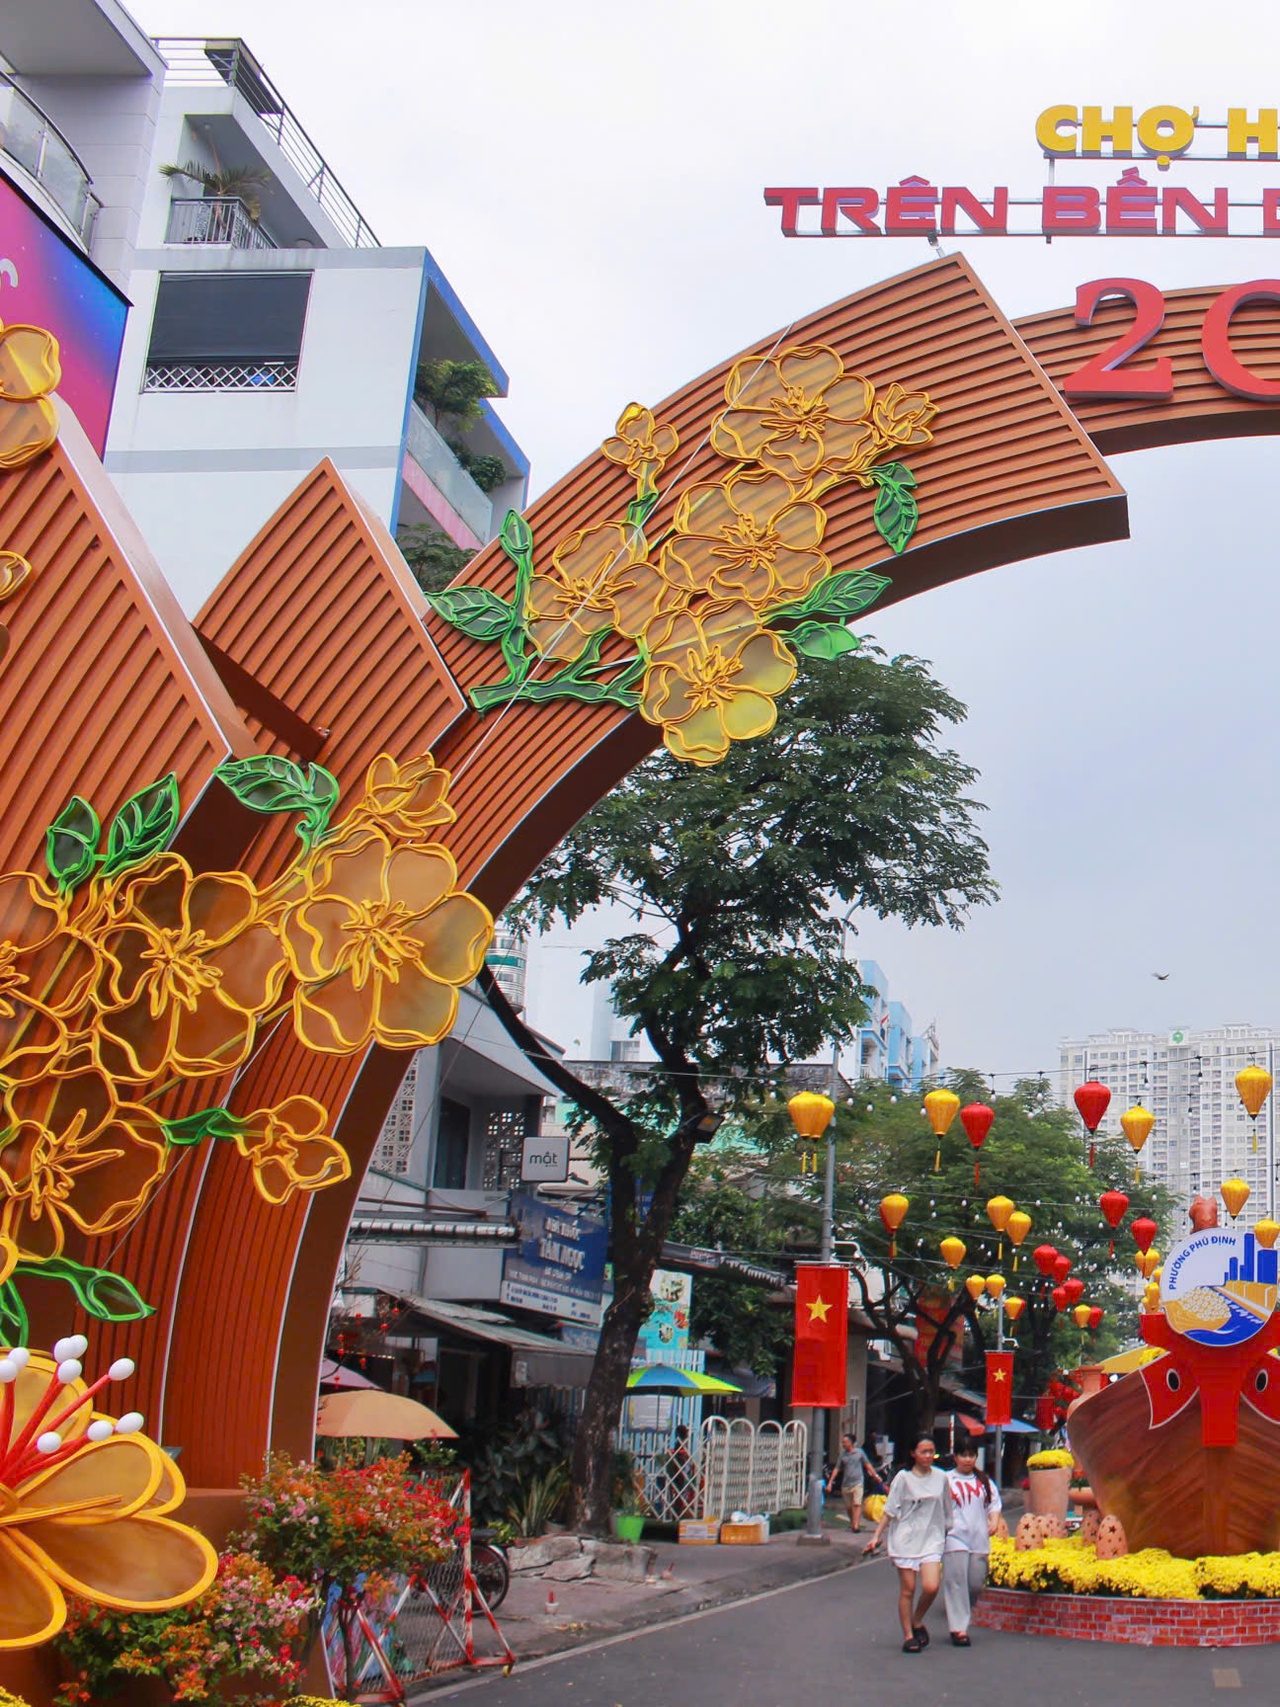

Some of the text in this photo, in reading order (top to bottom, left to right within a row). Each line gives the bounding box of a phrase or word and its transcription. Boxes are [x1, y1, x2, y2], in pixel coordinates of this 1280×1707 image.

[1035, 104, 1200, 171] CHỢ
[763, 174, 1009, 237] TRÊN
[1041, 167, 1229, 236] BẾN
[1168, 1235, 1237, 1291] PHƯỜNG PHÚ ĐỊNH
